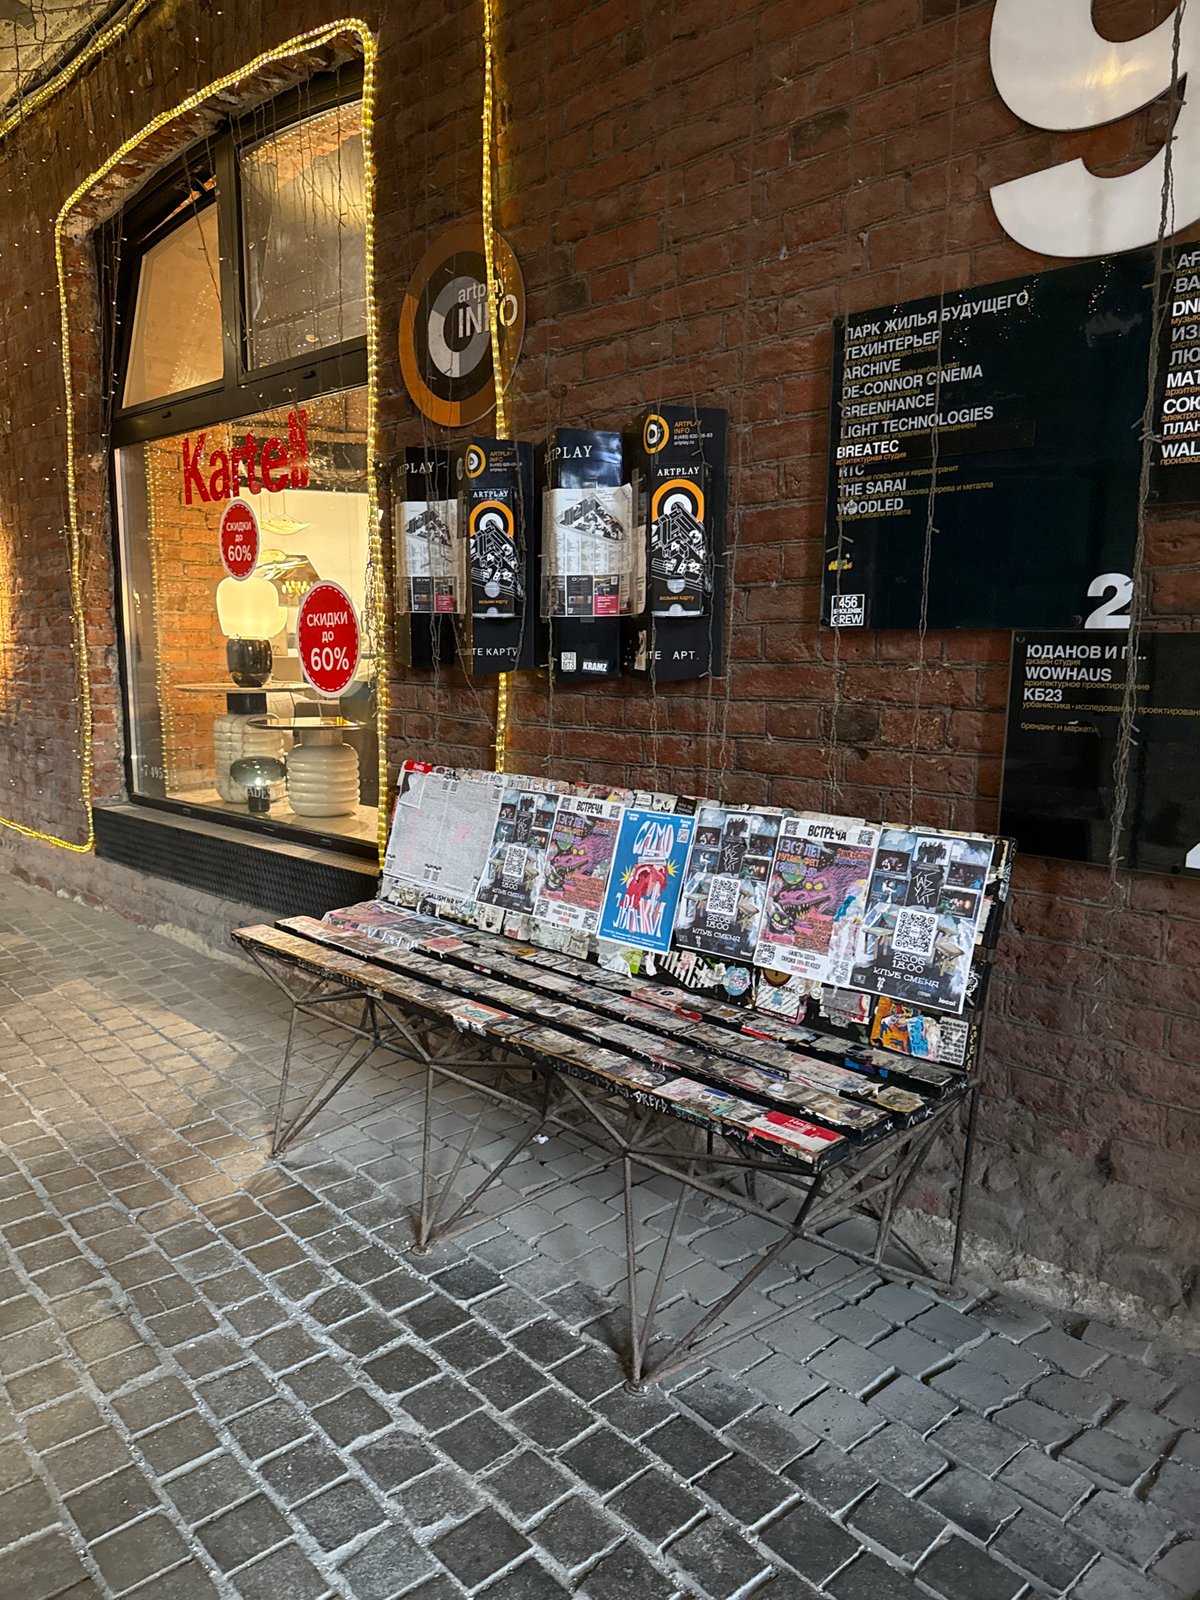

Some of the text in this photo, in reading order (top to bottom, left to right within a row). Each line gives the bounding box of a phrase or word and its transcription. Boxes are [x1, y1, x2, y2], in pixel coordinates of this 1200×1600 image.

[458, 277, 504, 303] artpay
[845, 290, 1029, 341] ПАРК ЖИЛЬЯ БУДУЩЕГО
[1172, 298, 1200, 317] DN
[846, 330, 941, 361] ТЕХИНТЕРЬЕР
[843, 358, 901, 381] ARCHIVE
[842, 374, 923, 400] DE-CONNOR
[842, 393, 935, 419] GREENHANCE
[673, 427, 690, 435] INFO
[841, 423, 881, 440] LIGHT
[883, 405, 994, 434] TECHNOLOGIES
[182, 409, 310, 505] Kartell
[836, 439, 899, 459] BREATEC
[657, 466, 700, 478] ARTPLAY
[473, 490, 509, 498] ARTPLAY
[838, 478, 906, 497] THE SARAI
[226, 521, 252, 533] СКИДКИ
[227, 545, 252, 563] 60%
[839, 596, 858, 608] 456
[1084, 573, 1135, 629] 2
[306, 611, 348, 628] СКИДКИ
[833, 607, 863, 615] SOLENSK
[310, 647, 349, 671] 60%
[1026, 645, 1101, 661] ЮДАНОВ
[1105, 646, 1117, 660] И
[582, 660, 608, 672] KRAMZ
[1054, 659, 1081, 667] студия
[1025, 666, 1112, 682] WOWHAUS
[1023, 688, 1063, 702] КБ23
[576, 801, 603, 815] ВСТРЕЧА
[633, 820, 674, 859] САМО
[873, 967, 940, 989] КЛУБ СМЕНА
[938, 997, 956, 1007] local
